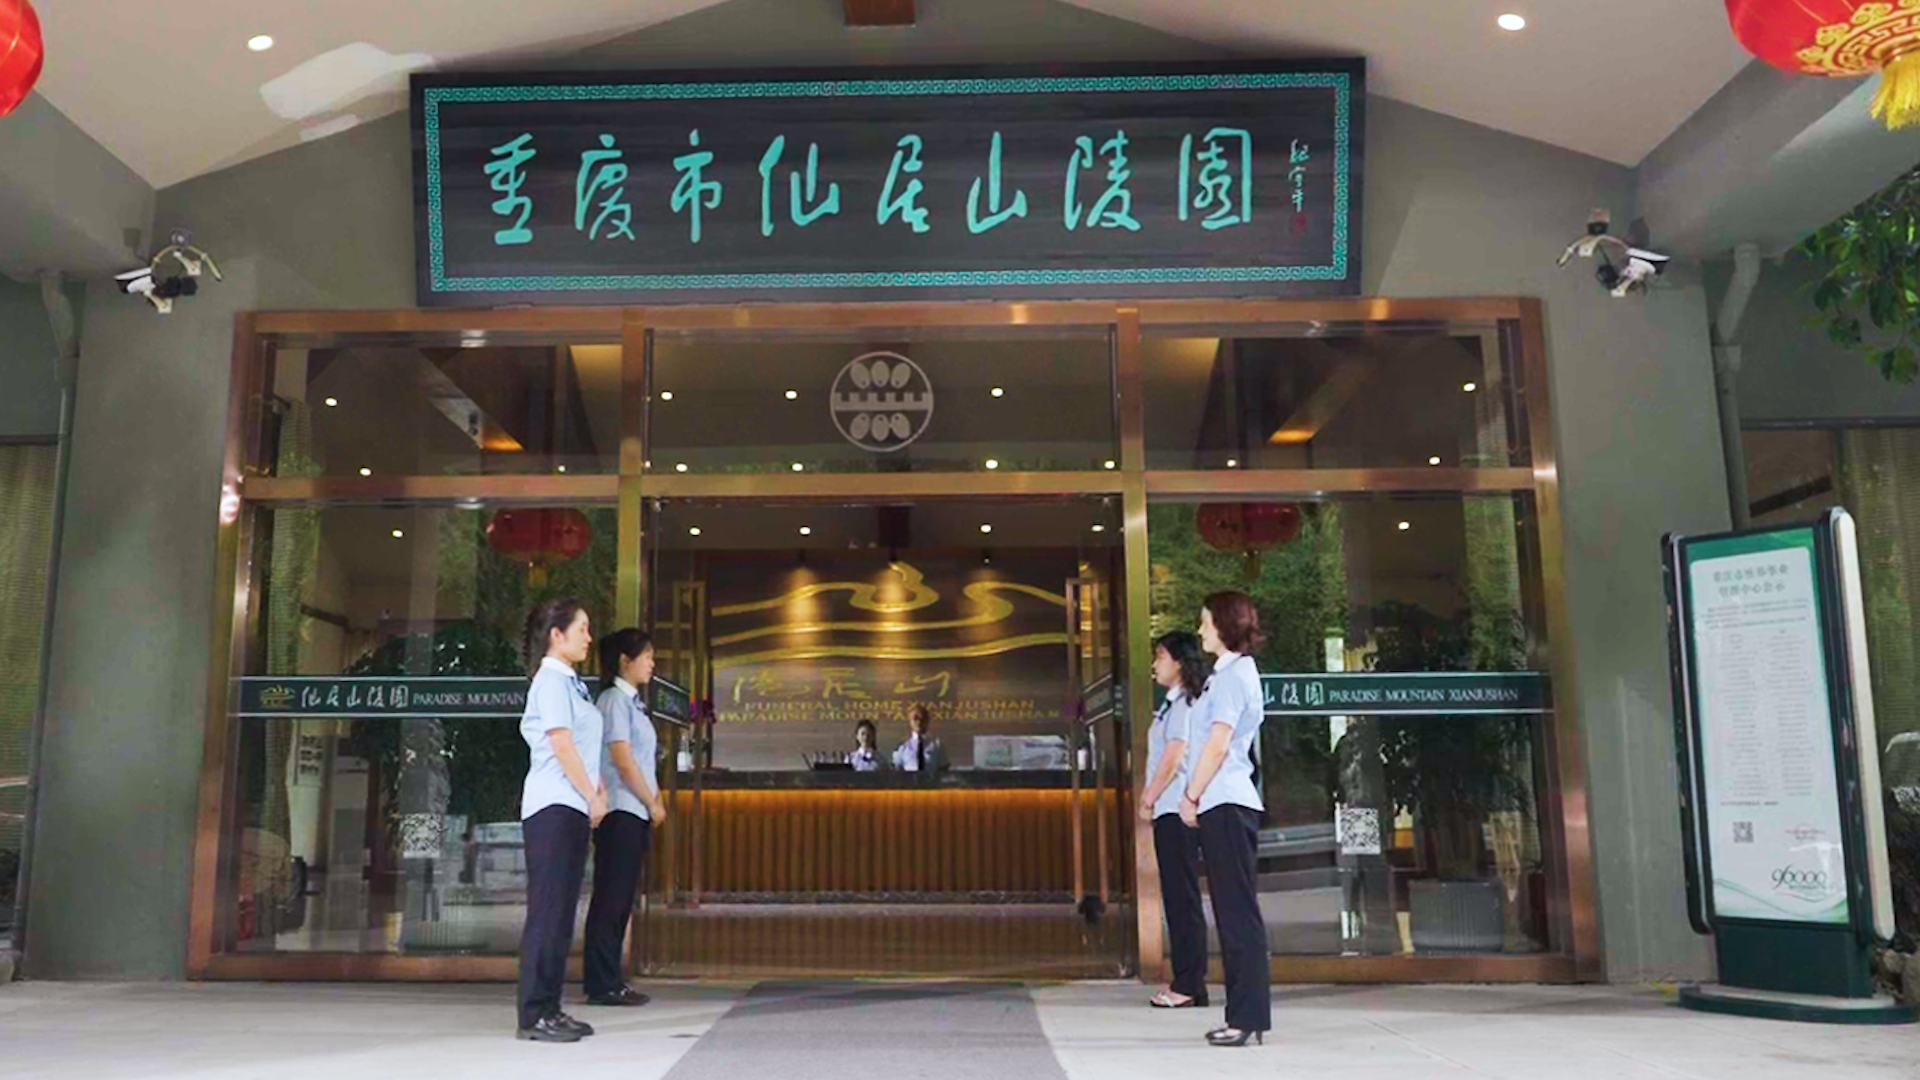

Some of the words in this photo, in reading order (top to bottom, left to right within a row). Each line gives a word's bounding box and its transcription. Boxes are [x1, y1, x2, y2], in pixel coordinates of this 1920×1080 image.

[412, 691, 463, 706] PARADISE
[1328, 688, 1381, 703] PARADISE
[1385, 687, 1445, 702] MOUNTAIN
